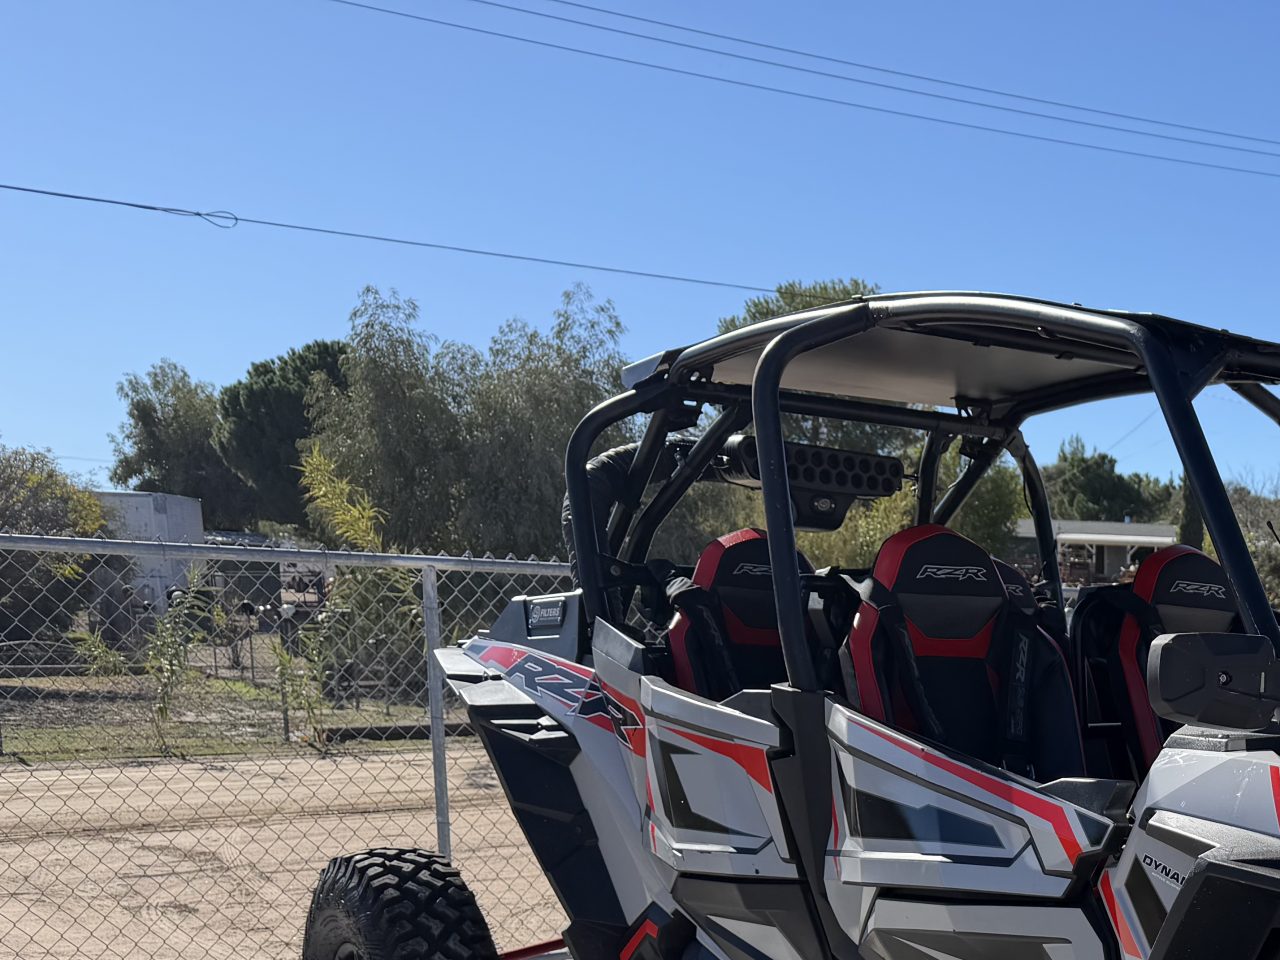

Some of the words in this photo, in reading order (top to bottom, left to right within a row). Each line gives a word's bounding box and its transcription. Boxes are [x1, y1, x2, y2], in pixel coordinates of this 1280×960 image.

[916, 564, 988, 581] RZR
[1169, 580, 1226, 599] RZR
[503, 651, 644, 750] RZR
